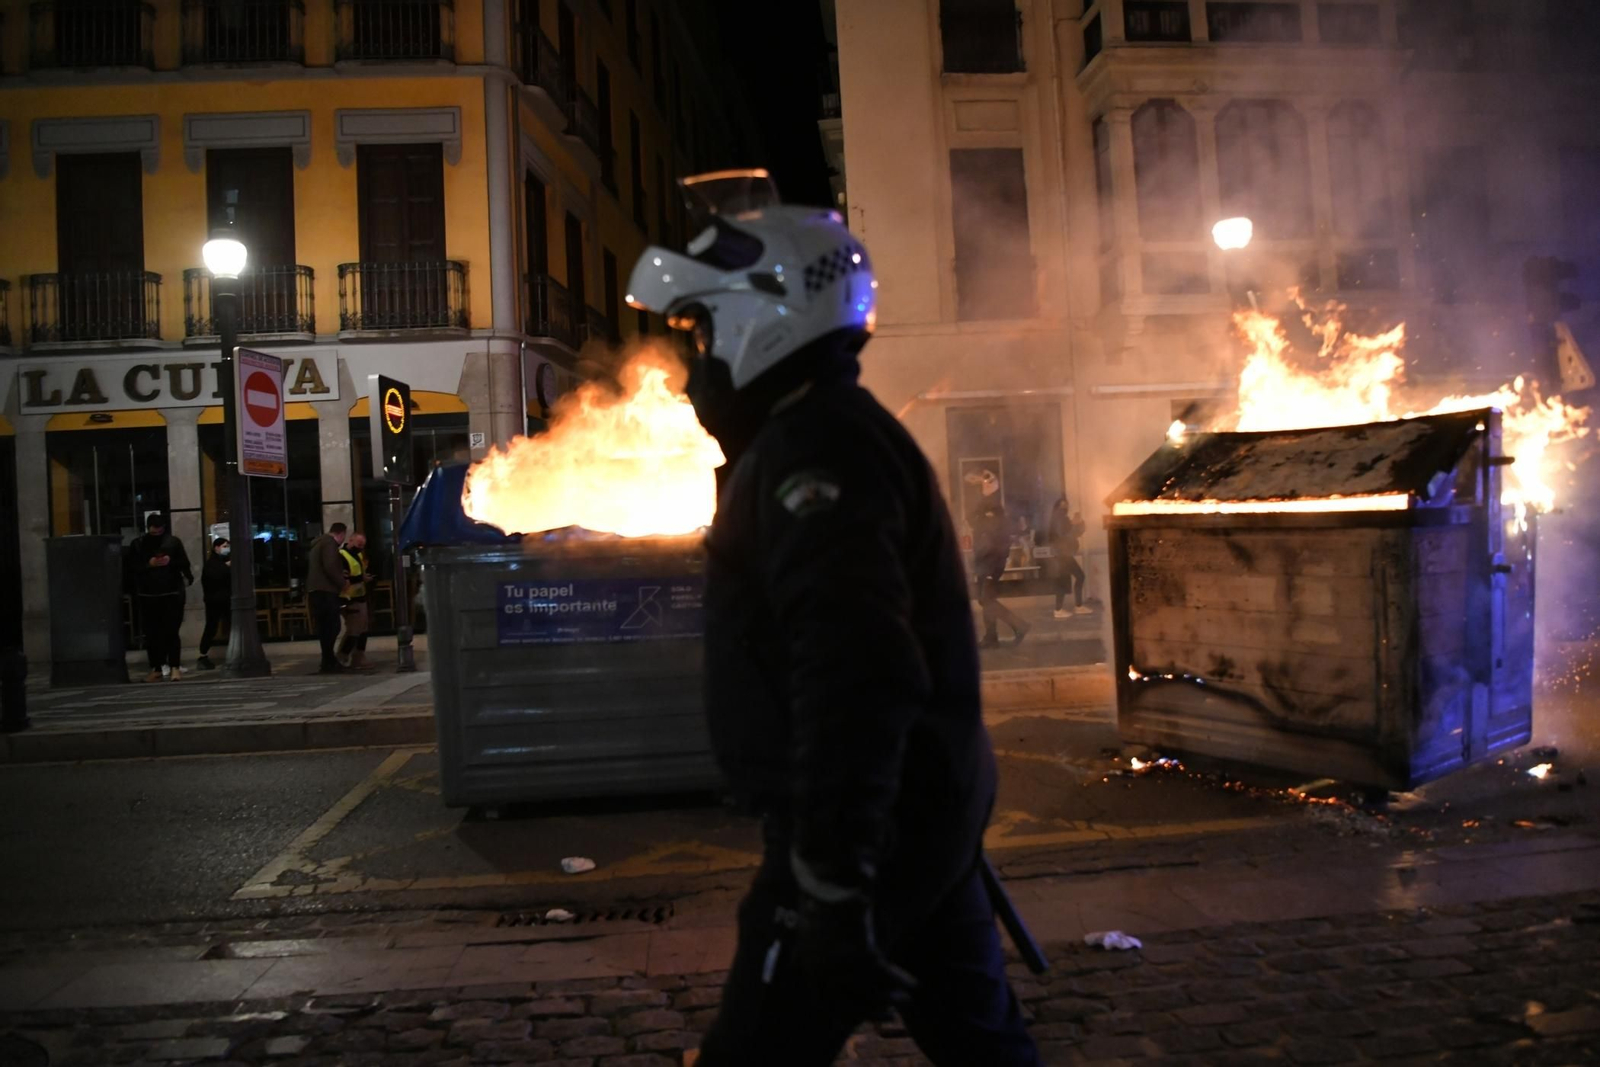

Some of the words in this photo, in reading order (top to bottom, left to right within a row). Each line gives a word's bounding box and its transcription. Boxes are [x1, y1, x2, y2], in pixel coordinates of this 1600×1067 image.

[22, 368, 108, 407] LA
[504, 585, 524, 598] Tu
[529, 583, 573, 600] papel
[504, 603, 524, 614] es
[529, 599, 617, 616] importante
